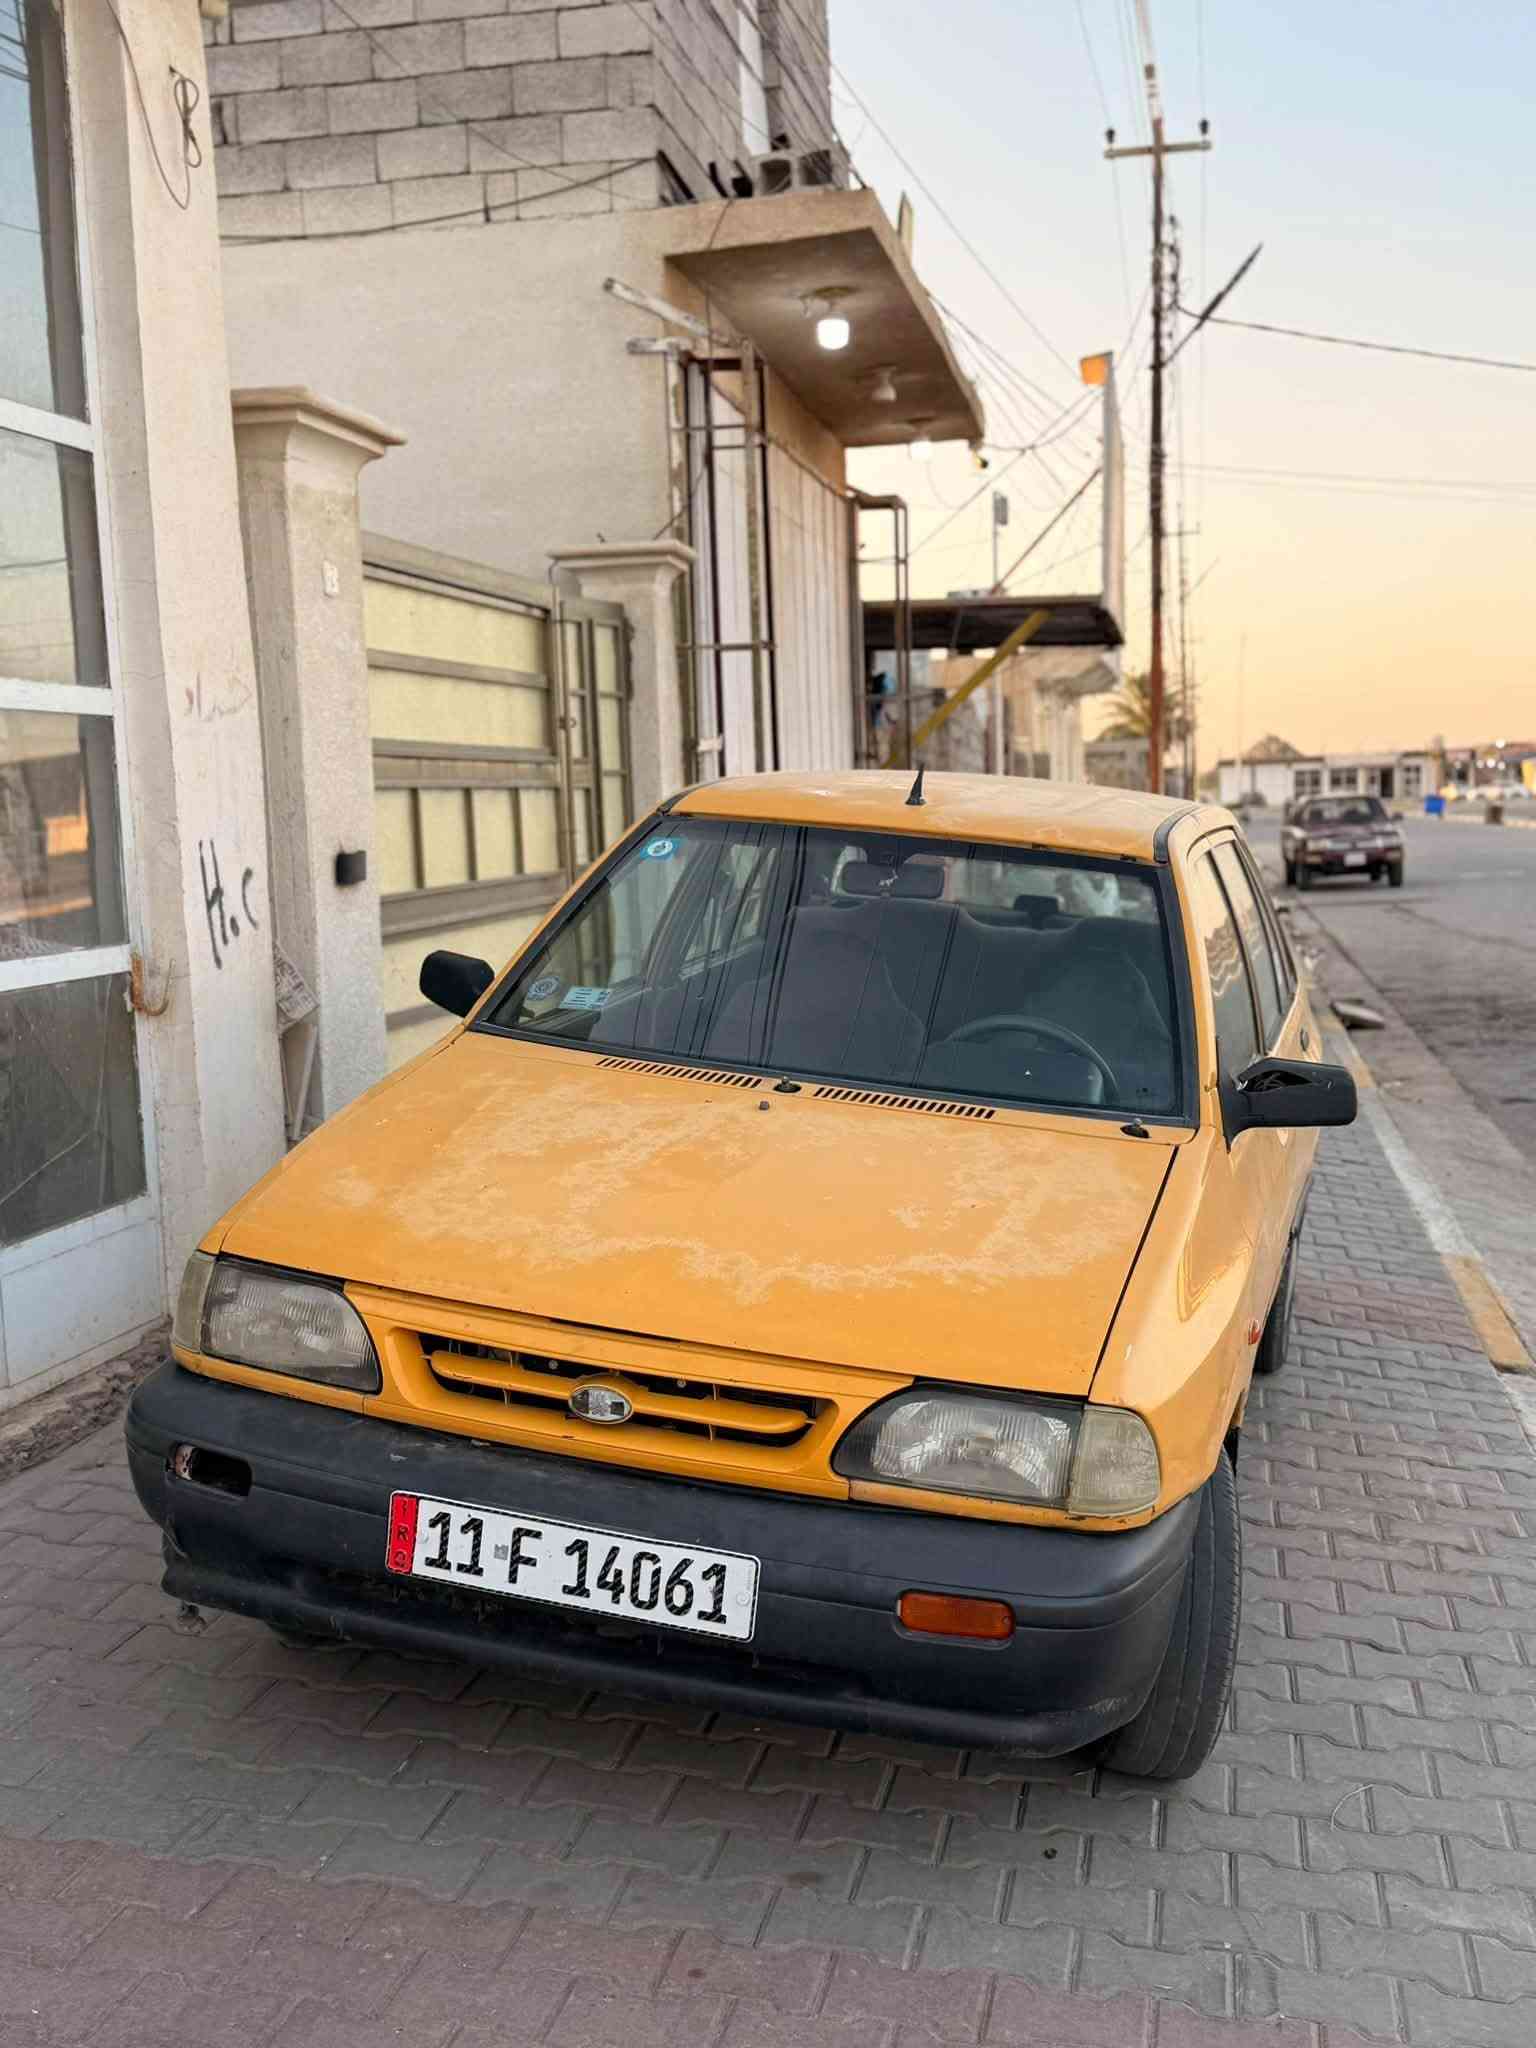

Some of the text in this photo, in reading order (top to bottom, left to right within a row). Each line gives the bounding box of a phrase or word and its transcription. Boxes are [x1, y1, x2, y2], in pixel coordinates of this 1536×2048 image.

[425, 1511, 728, 1625] 11 F 14061
